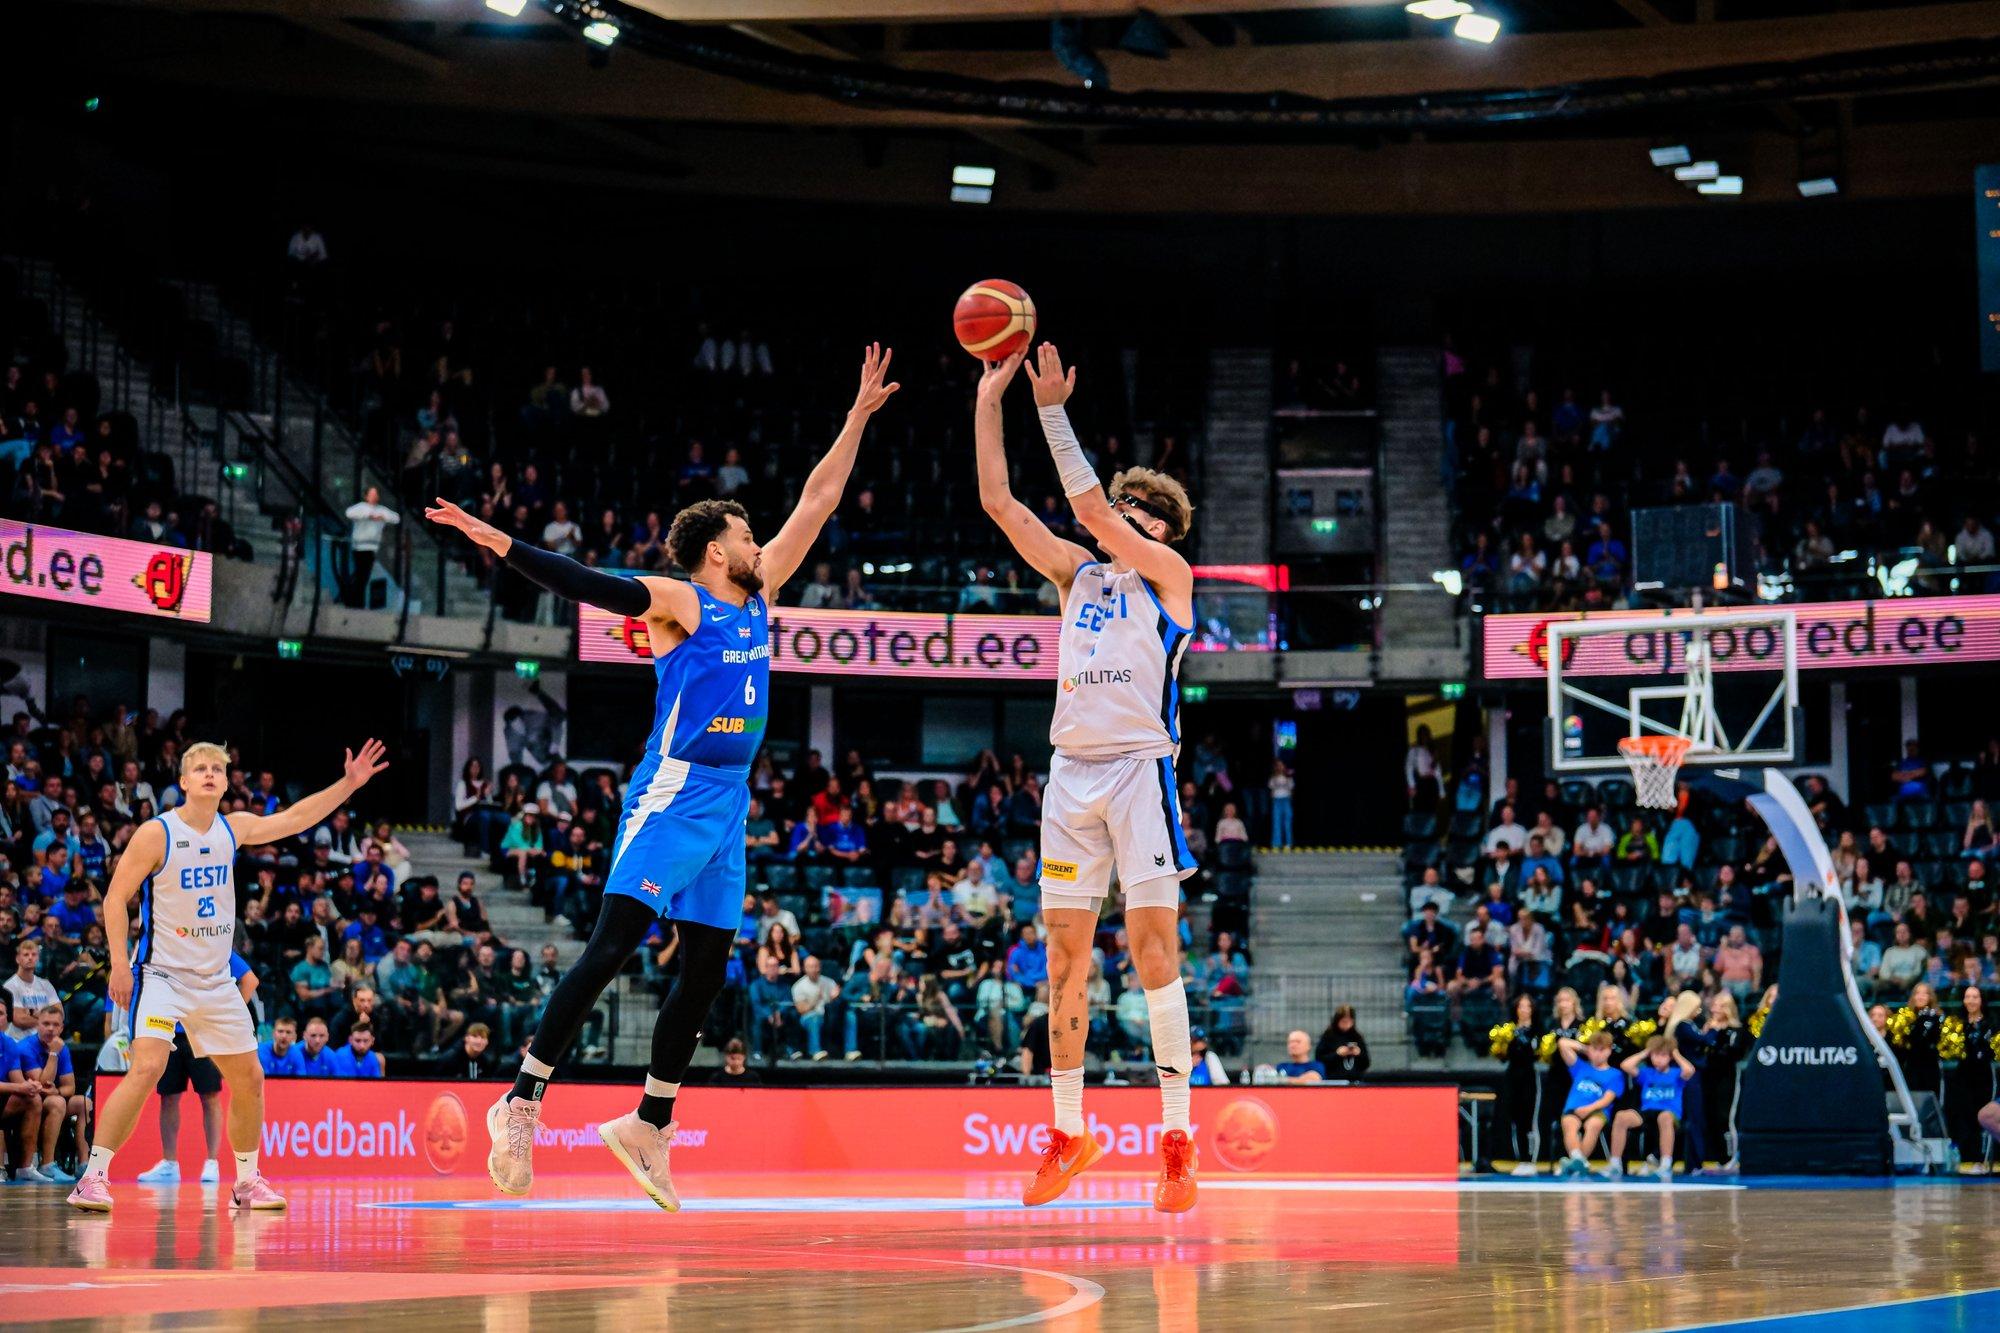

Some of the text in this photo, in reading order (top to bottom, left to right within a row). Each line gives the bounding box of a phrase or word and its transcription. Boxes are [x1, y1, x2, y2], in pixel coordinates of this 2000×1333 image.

[0, 523, 104, 595] d.ee
[768, 613, 1041, 669] tooted.ee
[744, 674, 756, 705] 6
[1077, 669, 1132, 685] TILITAS
[180, 864, 228, 890] EESTI
[197, 895, 216, 918] 25
[191, 923, 232, 938] UTILITAS
[1779, 1046, 1858, 1065] UTILITAS
[262, 1108, 416, 1157] wedbank
